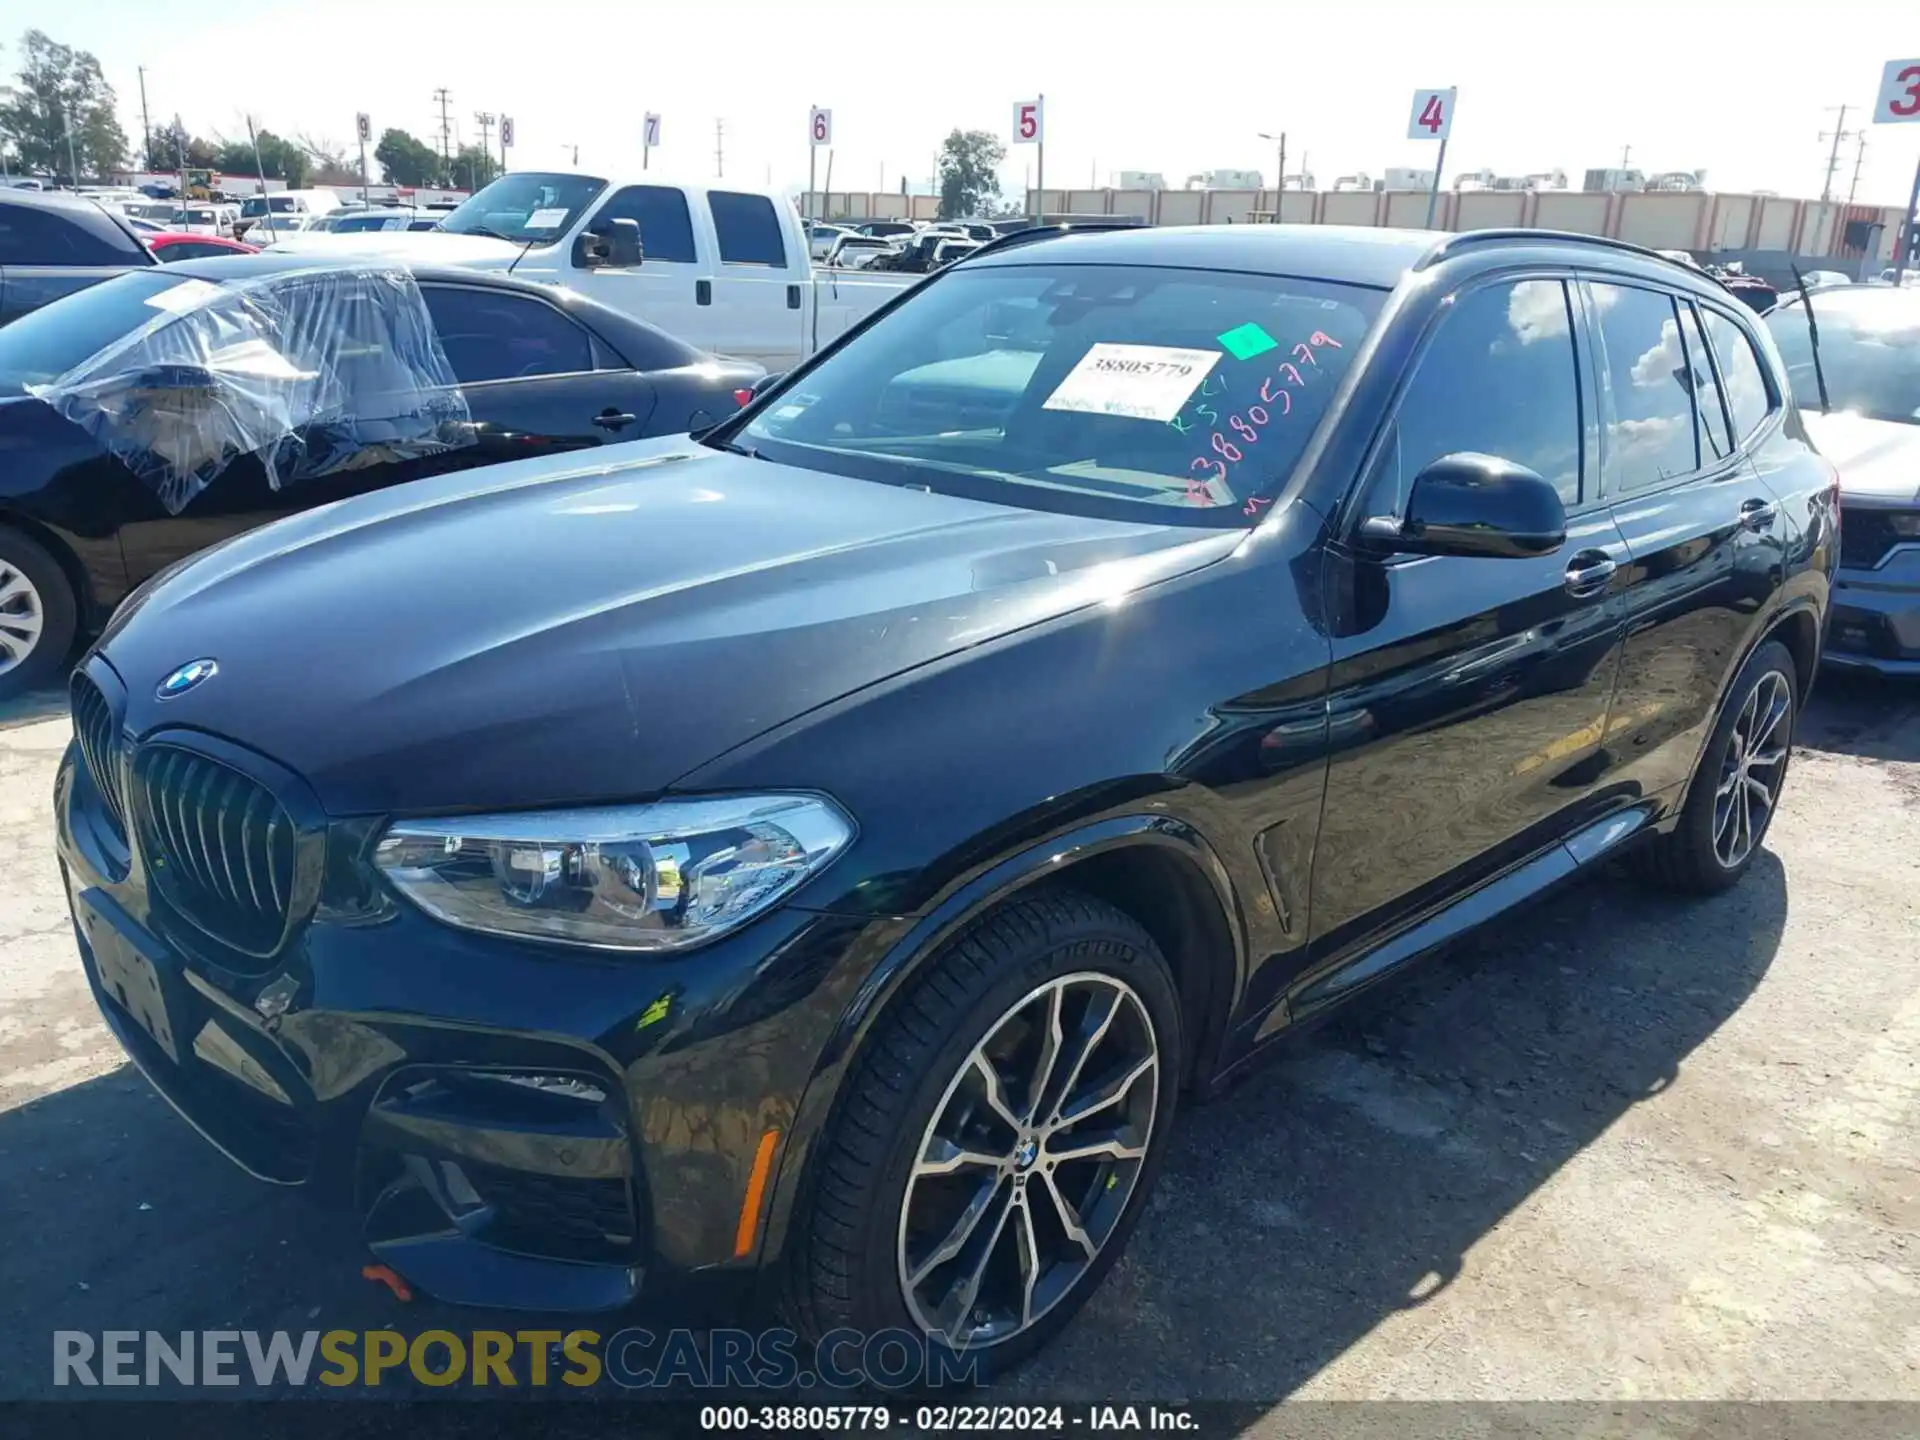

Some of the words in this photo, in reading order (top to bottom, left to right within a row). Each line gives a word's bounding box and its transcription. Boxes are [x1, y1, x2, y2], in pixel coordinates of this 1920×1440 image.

[1889, 65, 1920, 116] 3
[813, 113, 826, 140] 6
[1020, 106, 1036, 138] 5
[1418, 95, 1443, 133] 4
[359, 117, 368, 138] 9
[502, 121, 511, 143] 8
[647, 118, 657, 143] 7
[1089, 357, 1193, 378] 38805779
